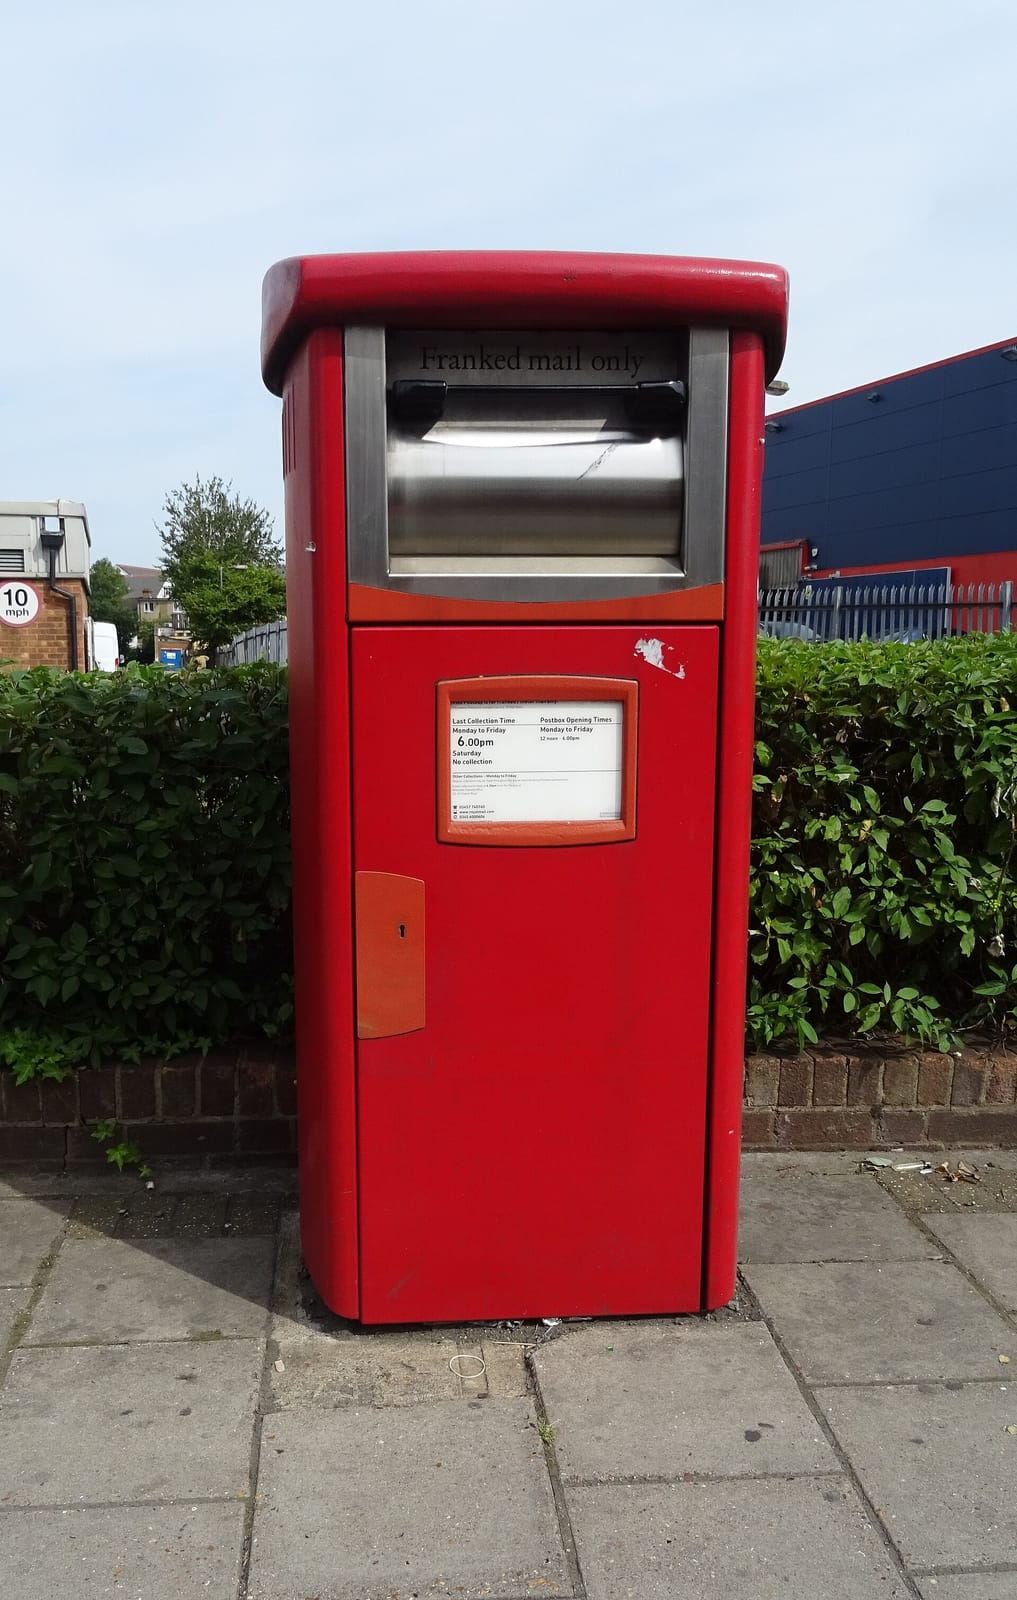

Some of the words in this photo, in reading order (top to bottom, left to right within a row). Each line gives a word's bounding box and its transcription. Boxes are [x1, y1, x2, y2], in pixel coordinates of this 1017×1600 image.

[419, 345, 520, 370] Franked
[527, 345, 582, 371] mail
[591, 346, 644, 378] only
[3, 588, 28, 607] 10
[5, 607, 30, 618] mph
[566, 716, 592, 724] Opening
[540, 726, 564, 734] Monday
[573, 725, 593, 733] Friday
[457, 735, 494, 747] 6.00pm
